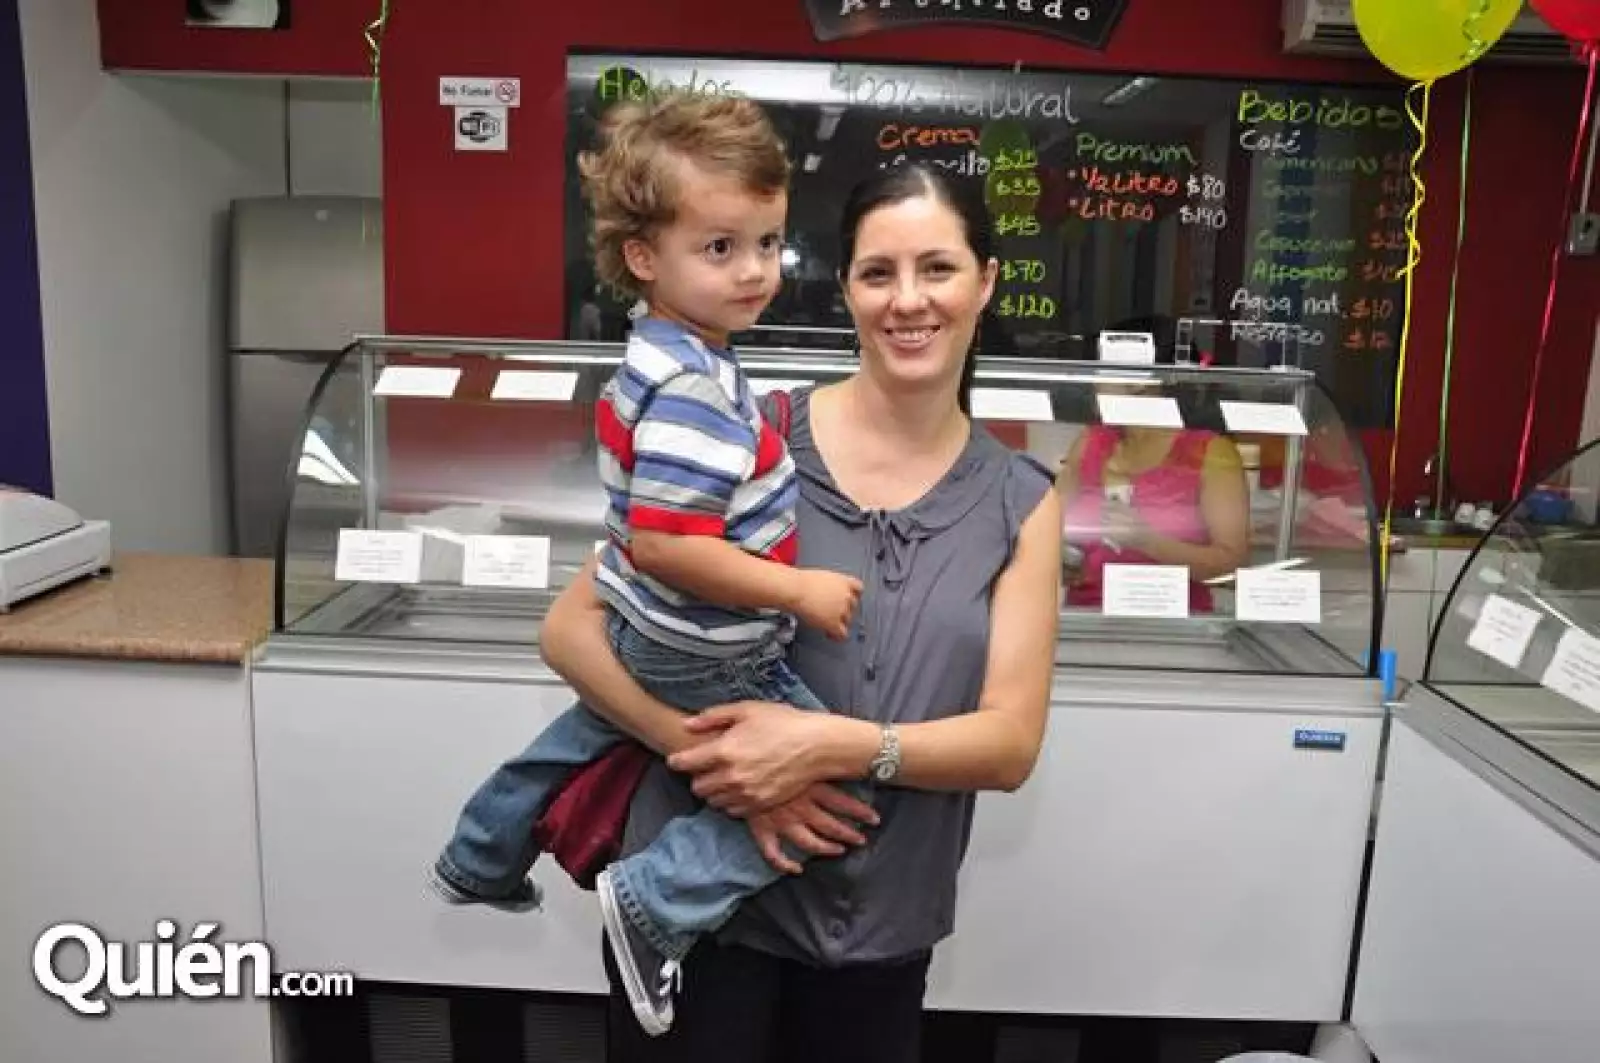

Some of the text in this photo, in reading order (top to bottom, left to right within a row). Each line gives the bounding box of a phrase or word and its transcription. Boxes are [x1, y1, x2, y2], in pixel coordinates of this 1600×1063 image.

[1237, 88, 1402, 129] Bebidas
[878, 124, 981, 150] Crema
[1076, 132, 1198, 164] Premium
[1239, 129, 1301, 156] Café
[1186, 174, 1226, 200] $80
[1178, 203, 1228, 229] $140
[1000, 258, 1047, 284] $70
[997, 292, 1056, 319] $120
[1229, 287, 1292, 320] Agua
